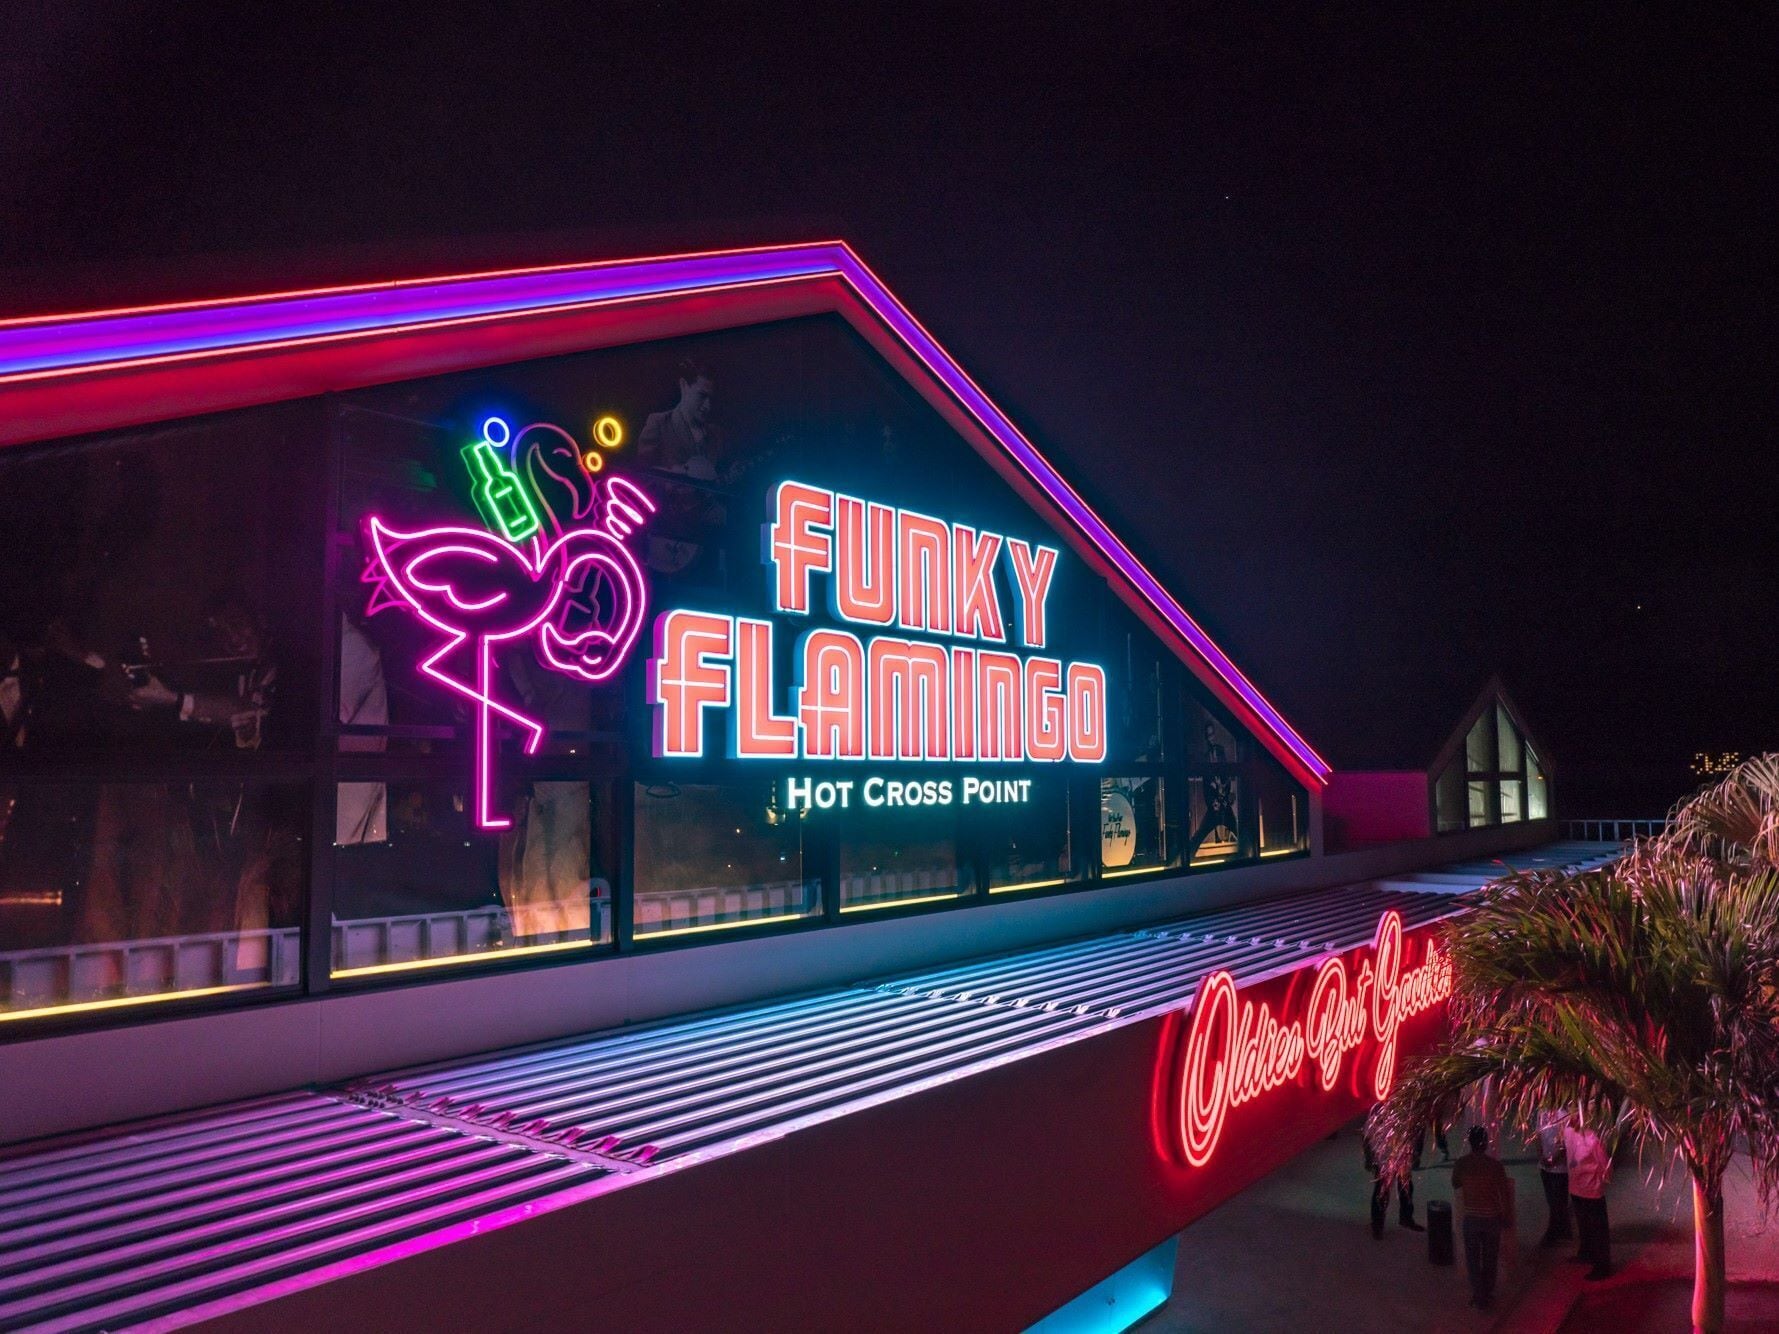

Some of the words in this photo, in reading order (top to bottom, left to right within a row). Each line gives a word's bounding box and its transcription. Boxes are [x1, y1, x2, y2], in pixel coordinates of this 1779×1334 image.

[768, 480, 1059, 648] FUNKY
[652, 608, 1107, 763] FLAMINGO
[787, 777, 853, 809] HOT
[863, 777, 953, 806] CROSS
[962, 776, 1032, 804] POINT
[1181, 971, 1304, 1167] Oldies
[1307, 957, 1373, 1091] But
